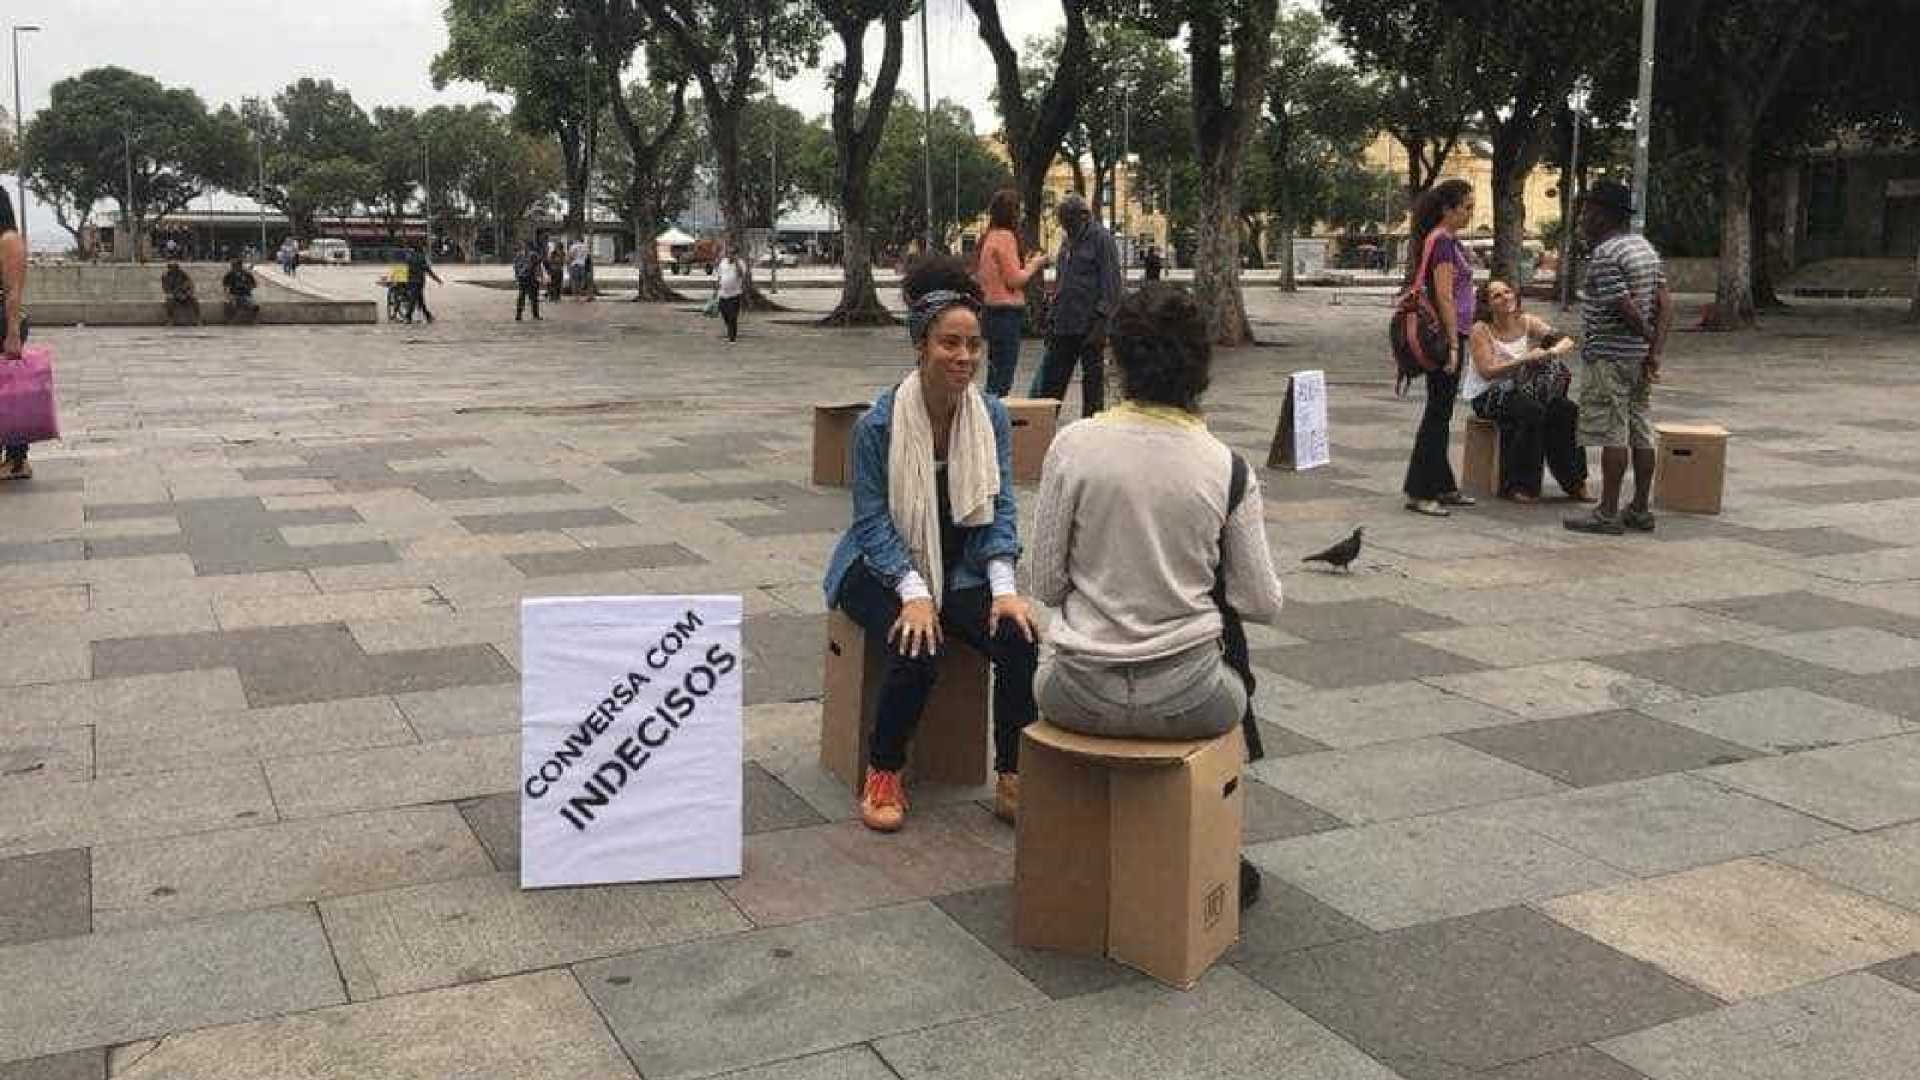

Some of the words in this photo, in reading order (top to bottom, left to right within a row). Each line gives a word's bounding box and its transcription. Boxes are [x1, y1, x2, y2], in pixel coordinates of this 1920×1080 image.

[525, 672, 650, 798] CONVERSA
[646, 610, 703, 669] COM
[560, 643, 736, 830] INDECISOS
